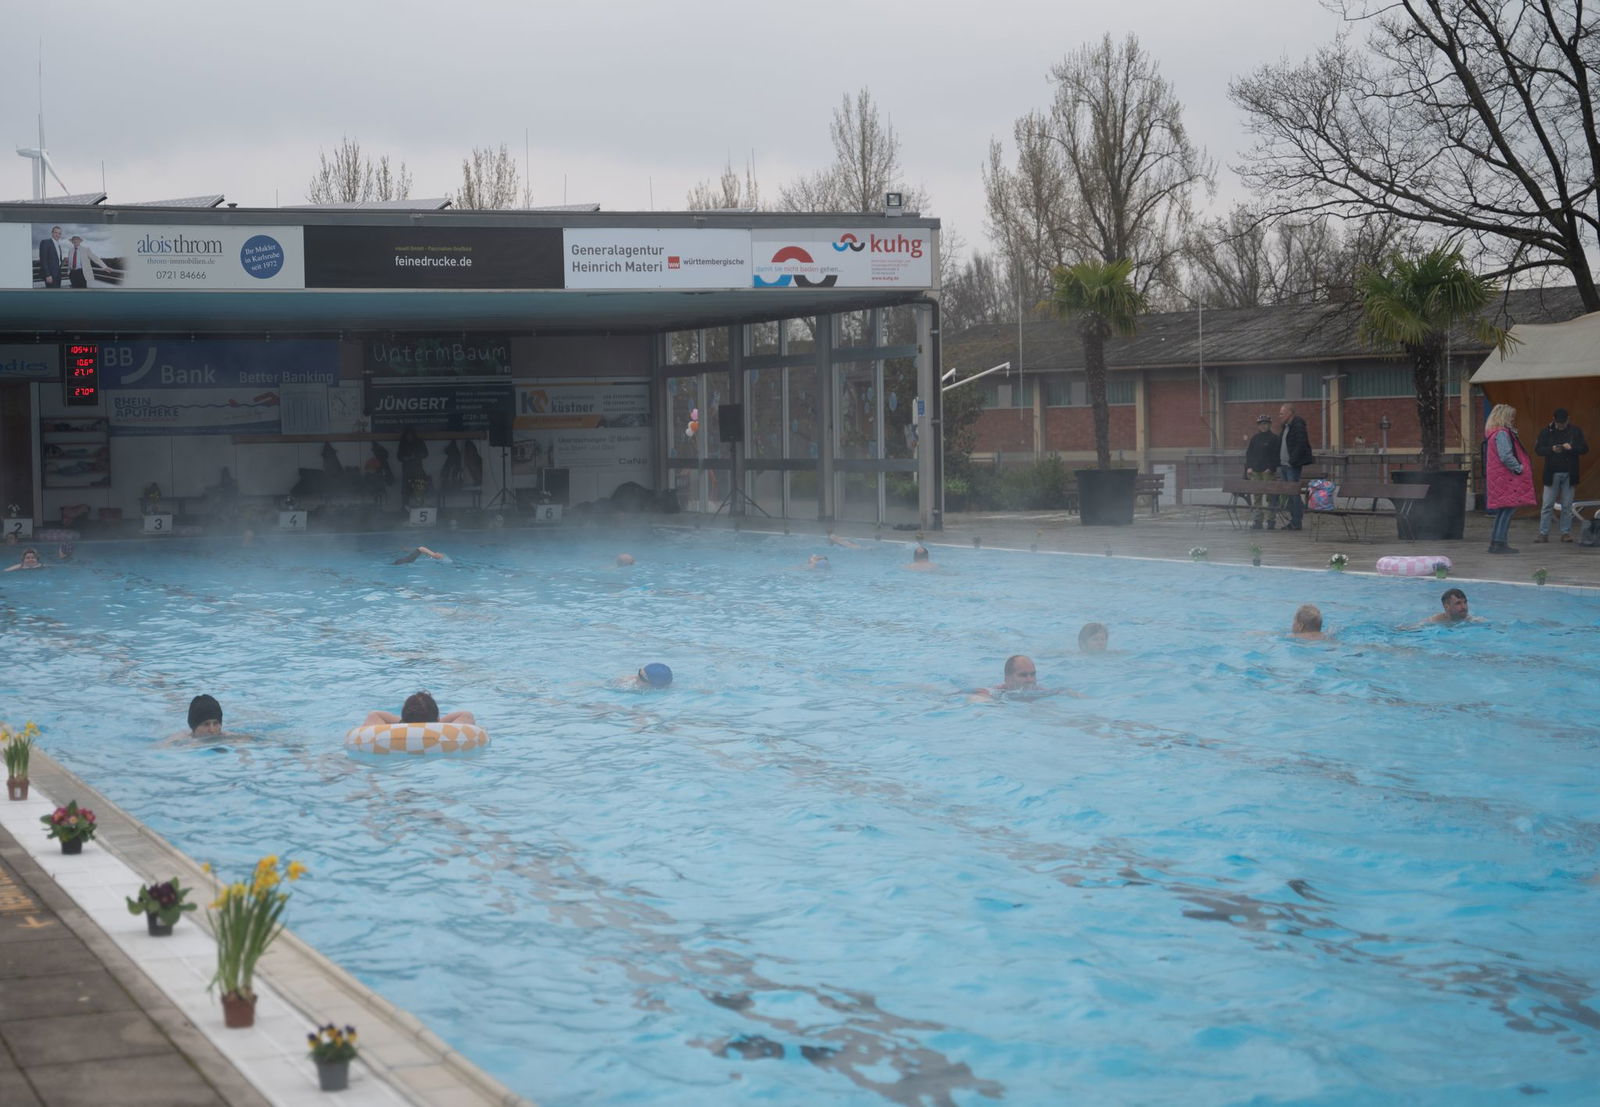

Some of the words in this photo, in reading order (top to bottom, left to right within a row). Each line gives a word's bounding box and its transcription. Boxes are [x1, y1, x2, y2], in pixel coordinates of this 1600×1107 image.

[571, 244, 665, 258] Generalagentur
[870, 233, 923, 258] kuhg
[395, 256, 473, 267] feinedrucke.de
[572, 261, 621, 273] Heinrich
[625, 261, 664, 273] Materi
[683, 257, 745, 267] württembergische
[156, 270, 177, 280] 0721
[179, 270, 207, 280] 84666
[104, 347, 133, 367] BB
[160, 364, 216, 385] Bank
[239, 372, 279, 384] Better
[282, 370, 335, 387] Banking
[114, 396, 152, 408] RHEIN
[375, 394, 449, 411] JÜNGERT
[551, 400, 595, 413] küstner
[114, 407, 179, 418] APOTHEKE
[419, 510, 429, 522] 5
[545, 508, 554, 519] 6
[154, 518, 163, 531] 3
[288, 514, 297, 527] 4
[14, 522, 23, 535] 2
